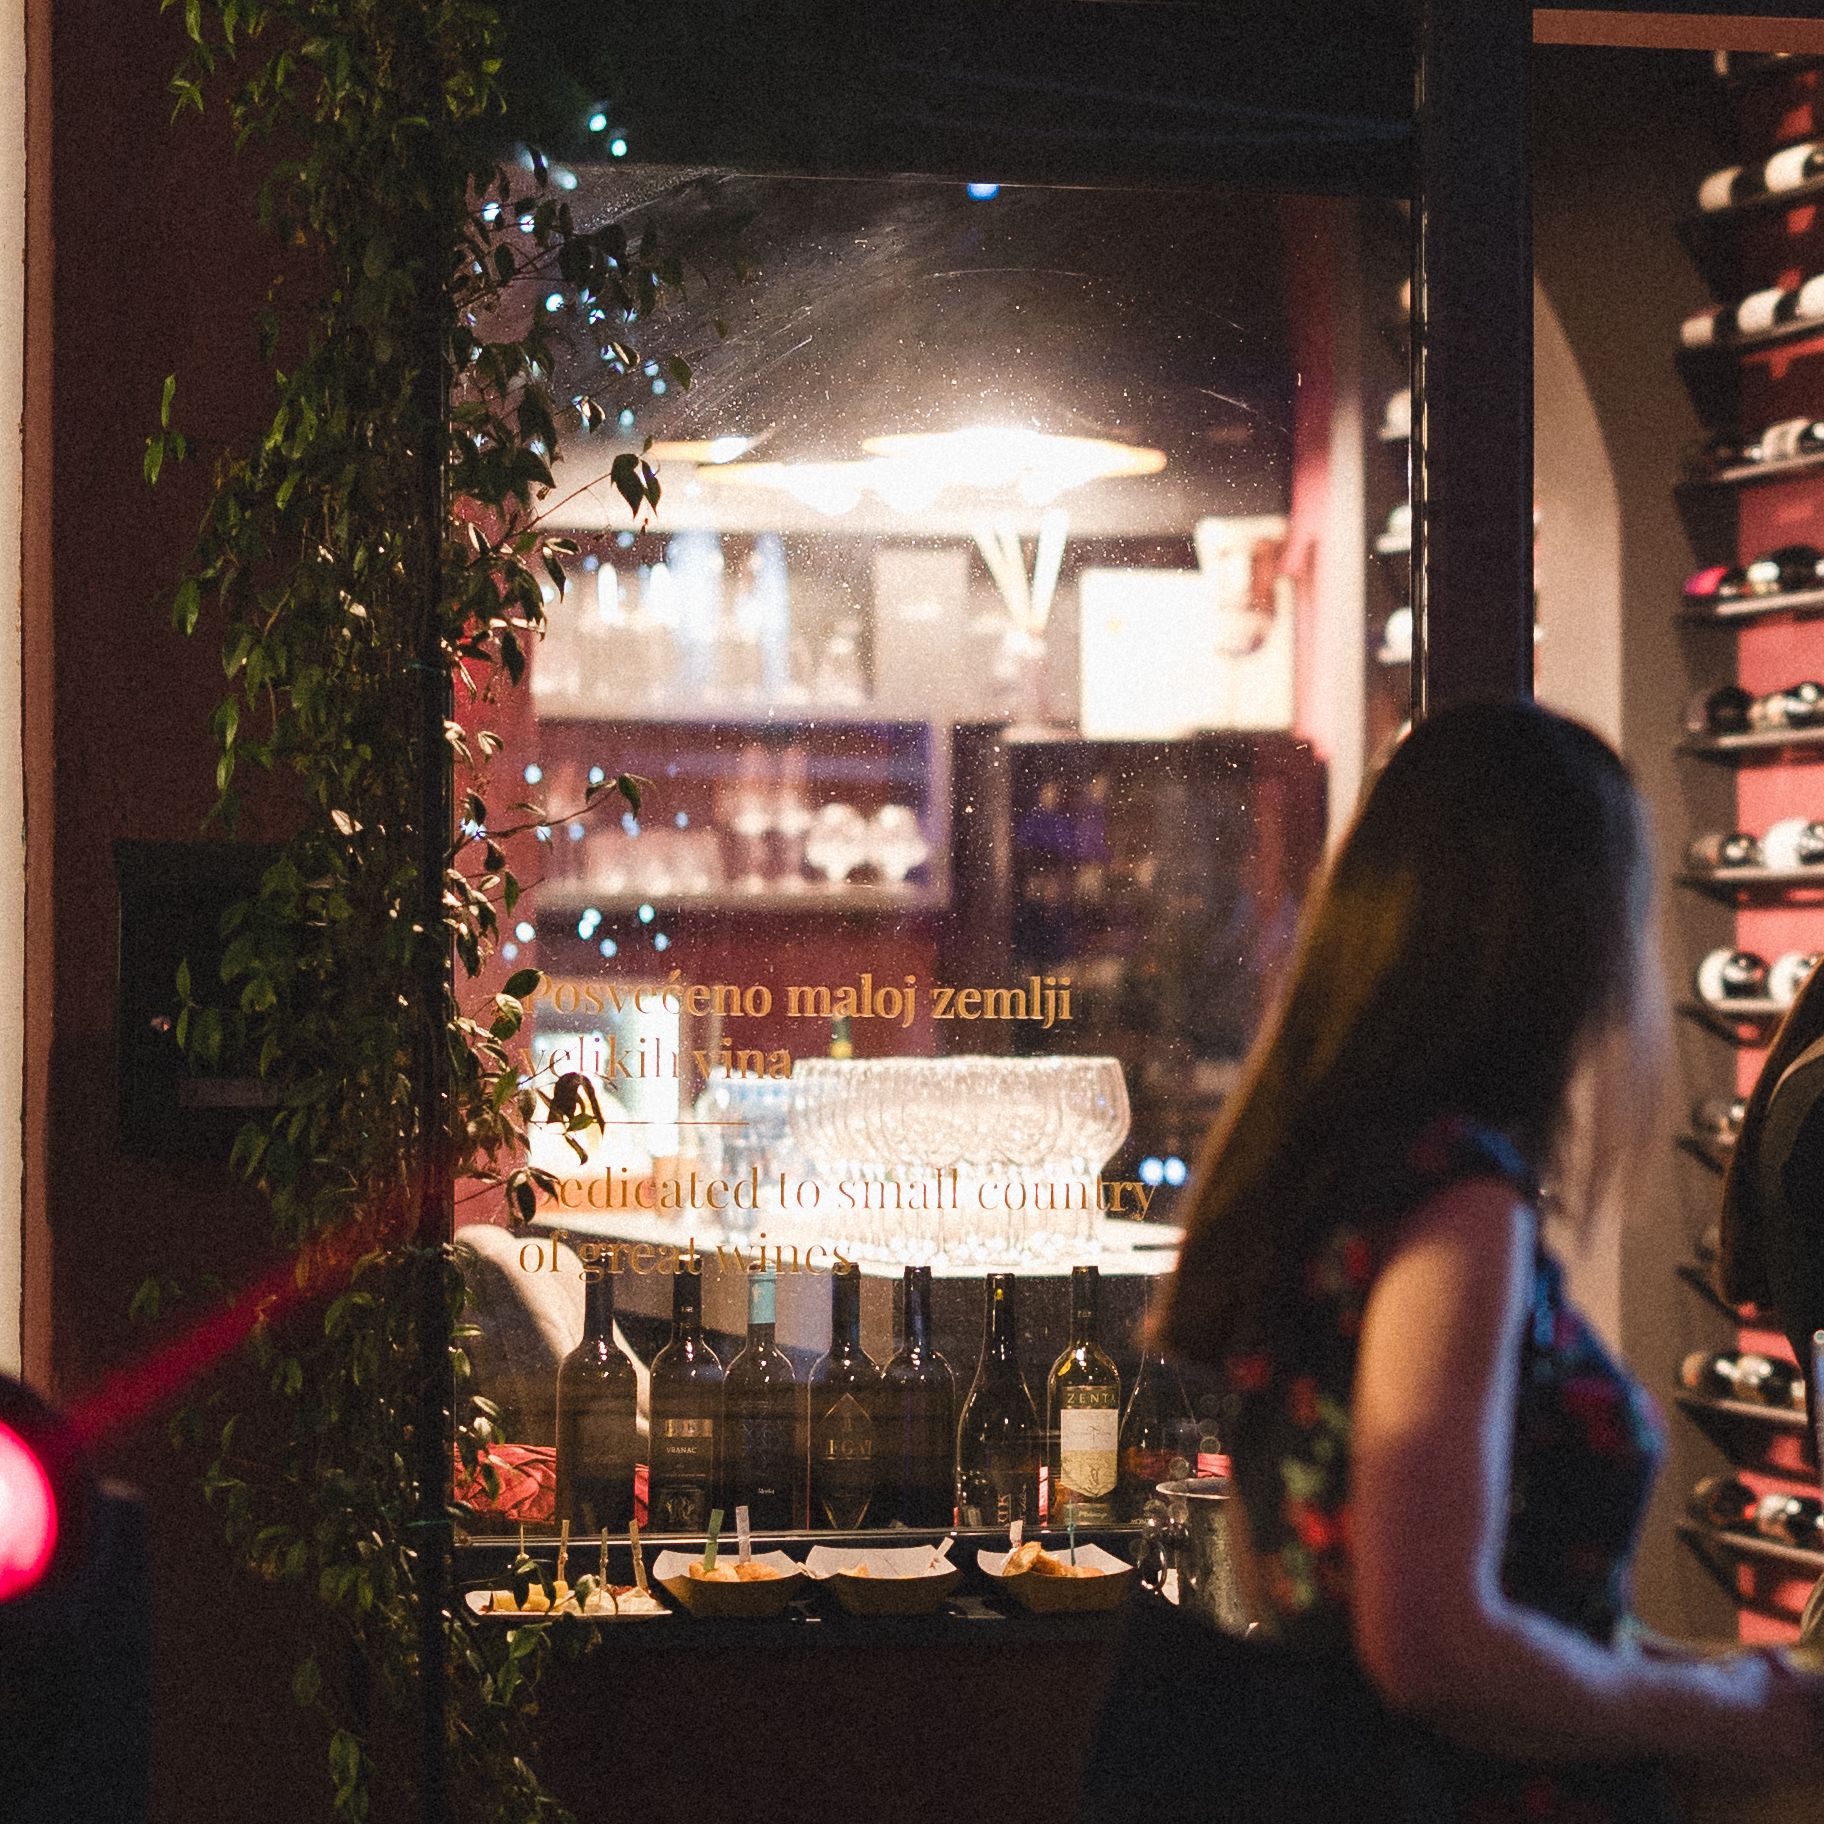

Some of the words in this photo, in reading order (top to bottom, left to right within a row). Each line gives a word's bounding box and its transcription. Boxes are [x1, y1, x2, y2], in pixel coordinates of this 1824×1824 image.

[787, 973, 917, 1028] maloj
[931, 975, 1073, 1029] zemlji
[521, 1034, 680, 1079] velikih
[692, 1037, 795, 1080] vina
[535, 1167, 760, 1210] edicated
[779, 1172, 821, 1209] to
[838, 1168, 960, 1211] small
[978, 1171, 1157, 1221] country
[519, 1228, 569, 1273] of
[578, 1236, 704, 1283] great
[716, 1232, 853, 1276] wines
